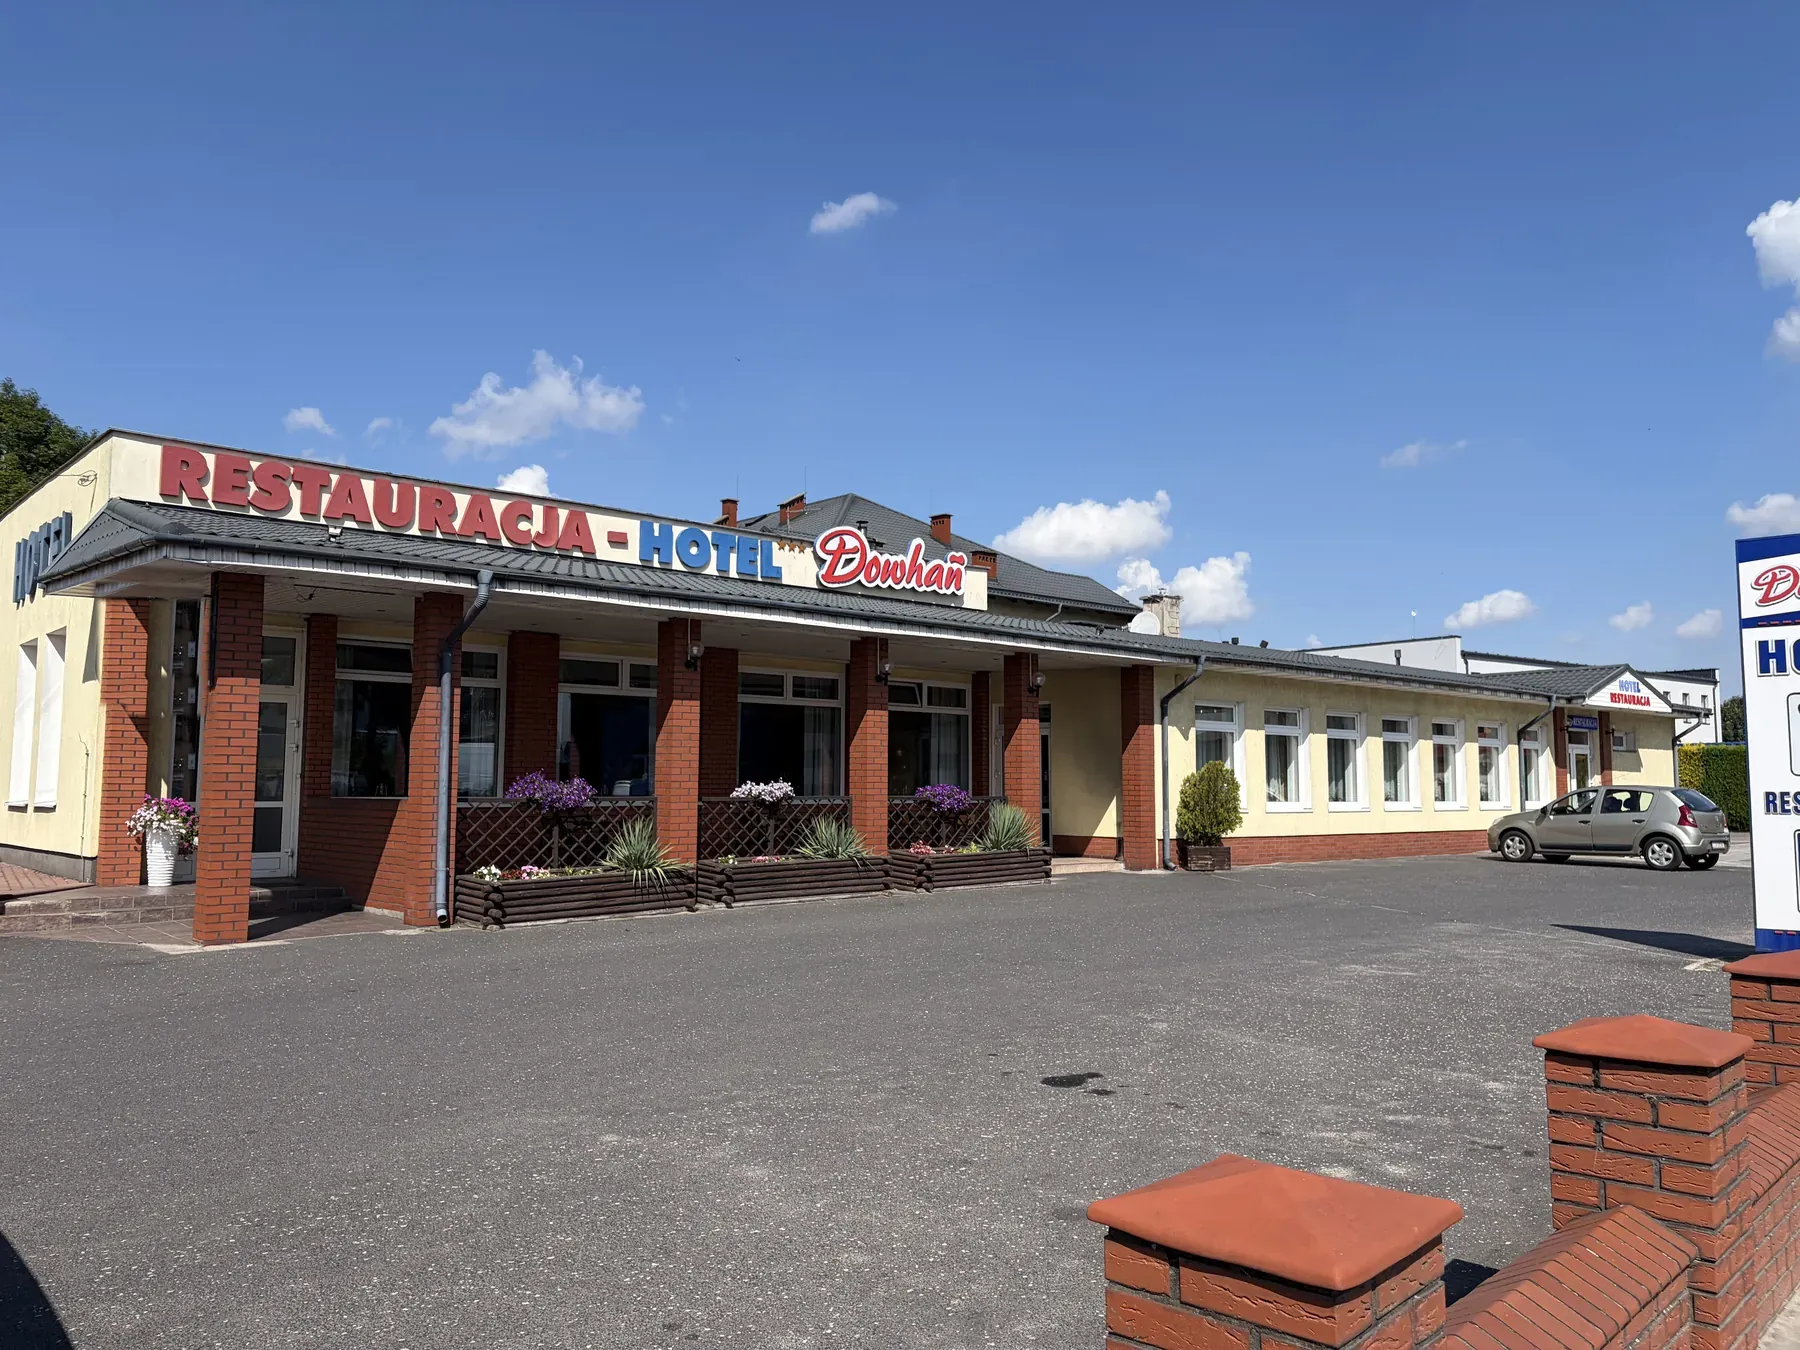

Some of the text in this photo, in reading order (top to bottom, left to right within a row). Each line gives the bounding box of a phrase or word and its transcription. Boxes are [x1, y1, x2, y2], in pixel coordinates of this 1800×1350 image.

[160, 444, 596, 554] RESTAURACJA
[639, 520, 782, 580] HOTEL
[1757, 639, 1800, 677] H
[1610, 692, 1651, 706] RESTAURACJA
[1619, 679, 1641, 693] HOTEL
